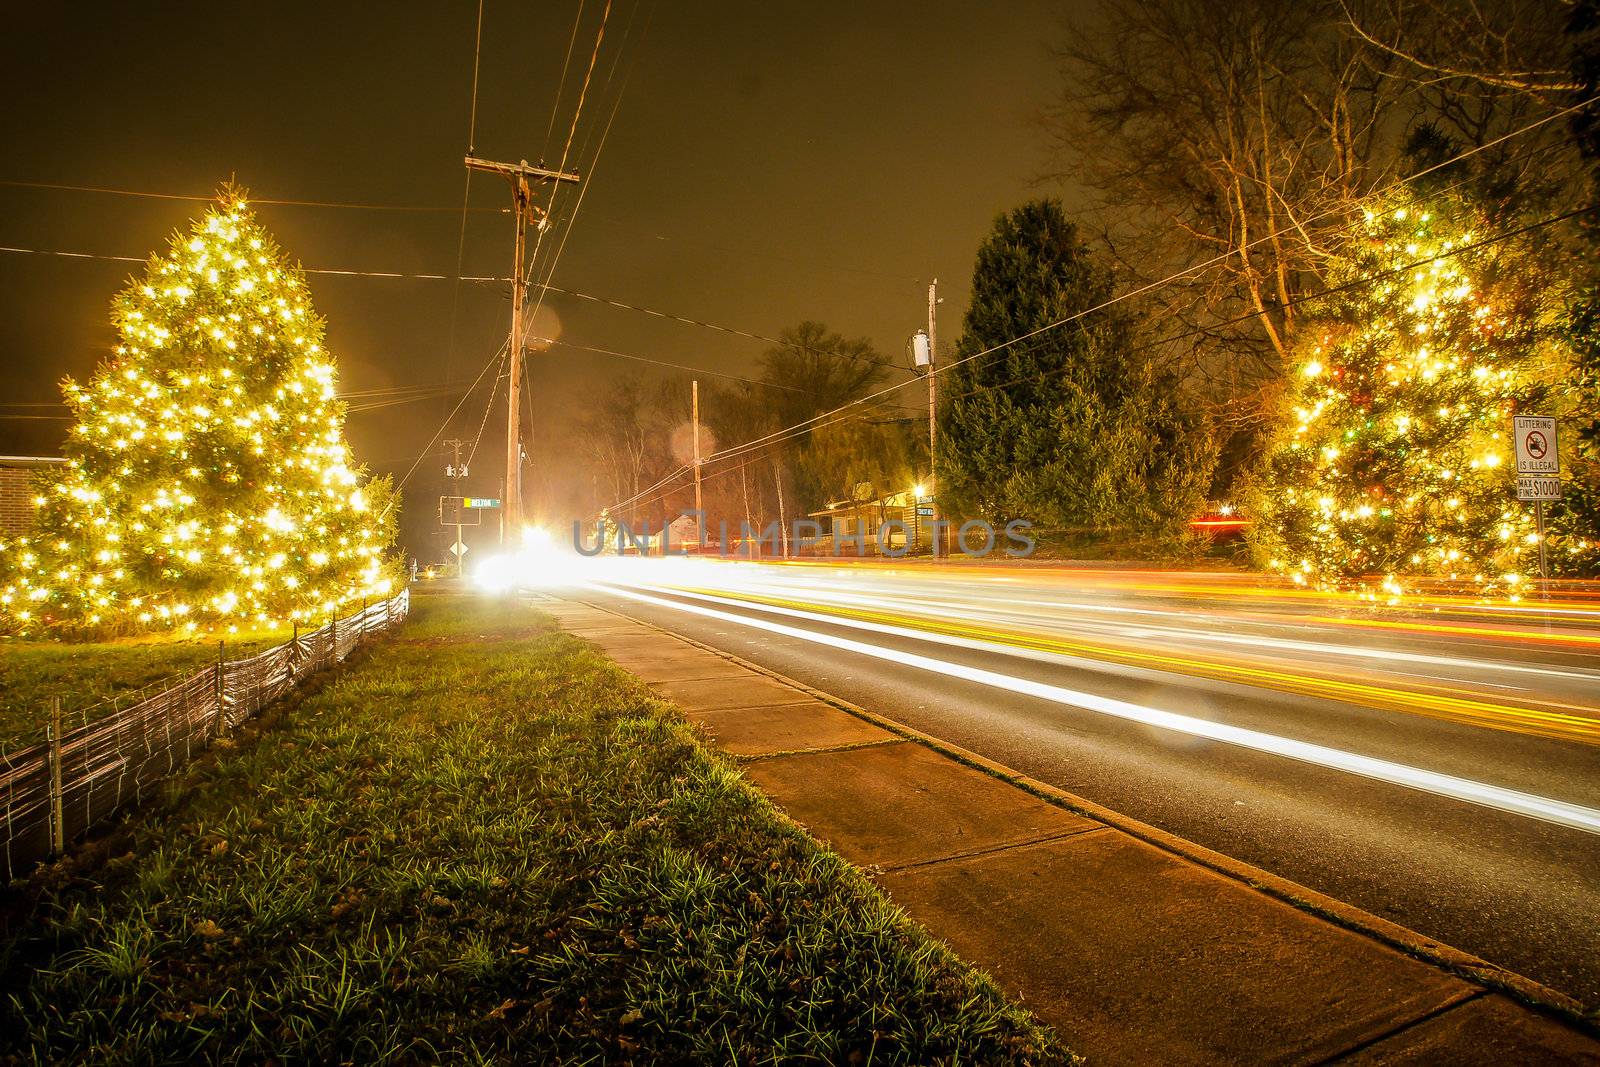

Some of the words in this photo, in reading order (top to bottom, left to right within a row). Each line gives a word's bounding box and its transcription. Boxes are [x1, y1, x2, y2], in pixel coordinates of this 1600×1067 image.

[1518, 420, 1552, 429] LITTERING
[1520, 461, 1527, 470] IS
[1529, 461, 1556, 471] ILLEGAL
[1518, 479, 1532, 487] MAX
[1519, 489, 1533, 497] FINE
[1534, 481, 1560, 496] $1000
